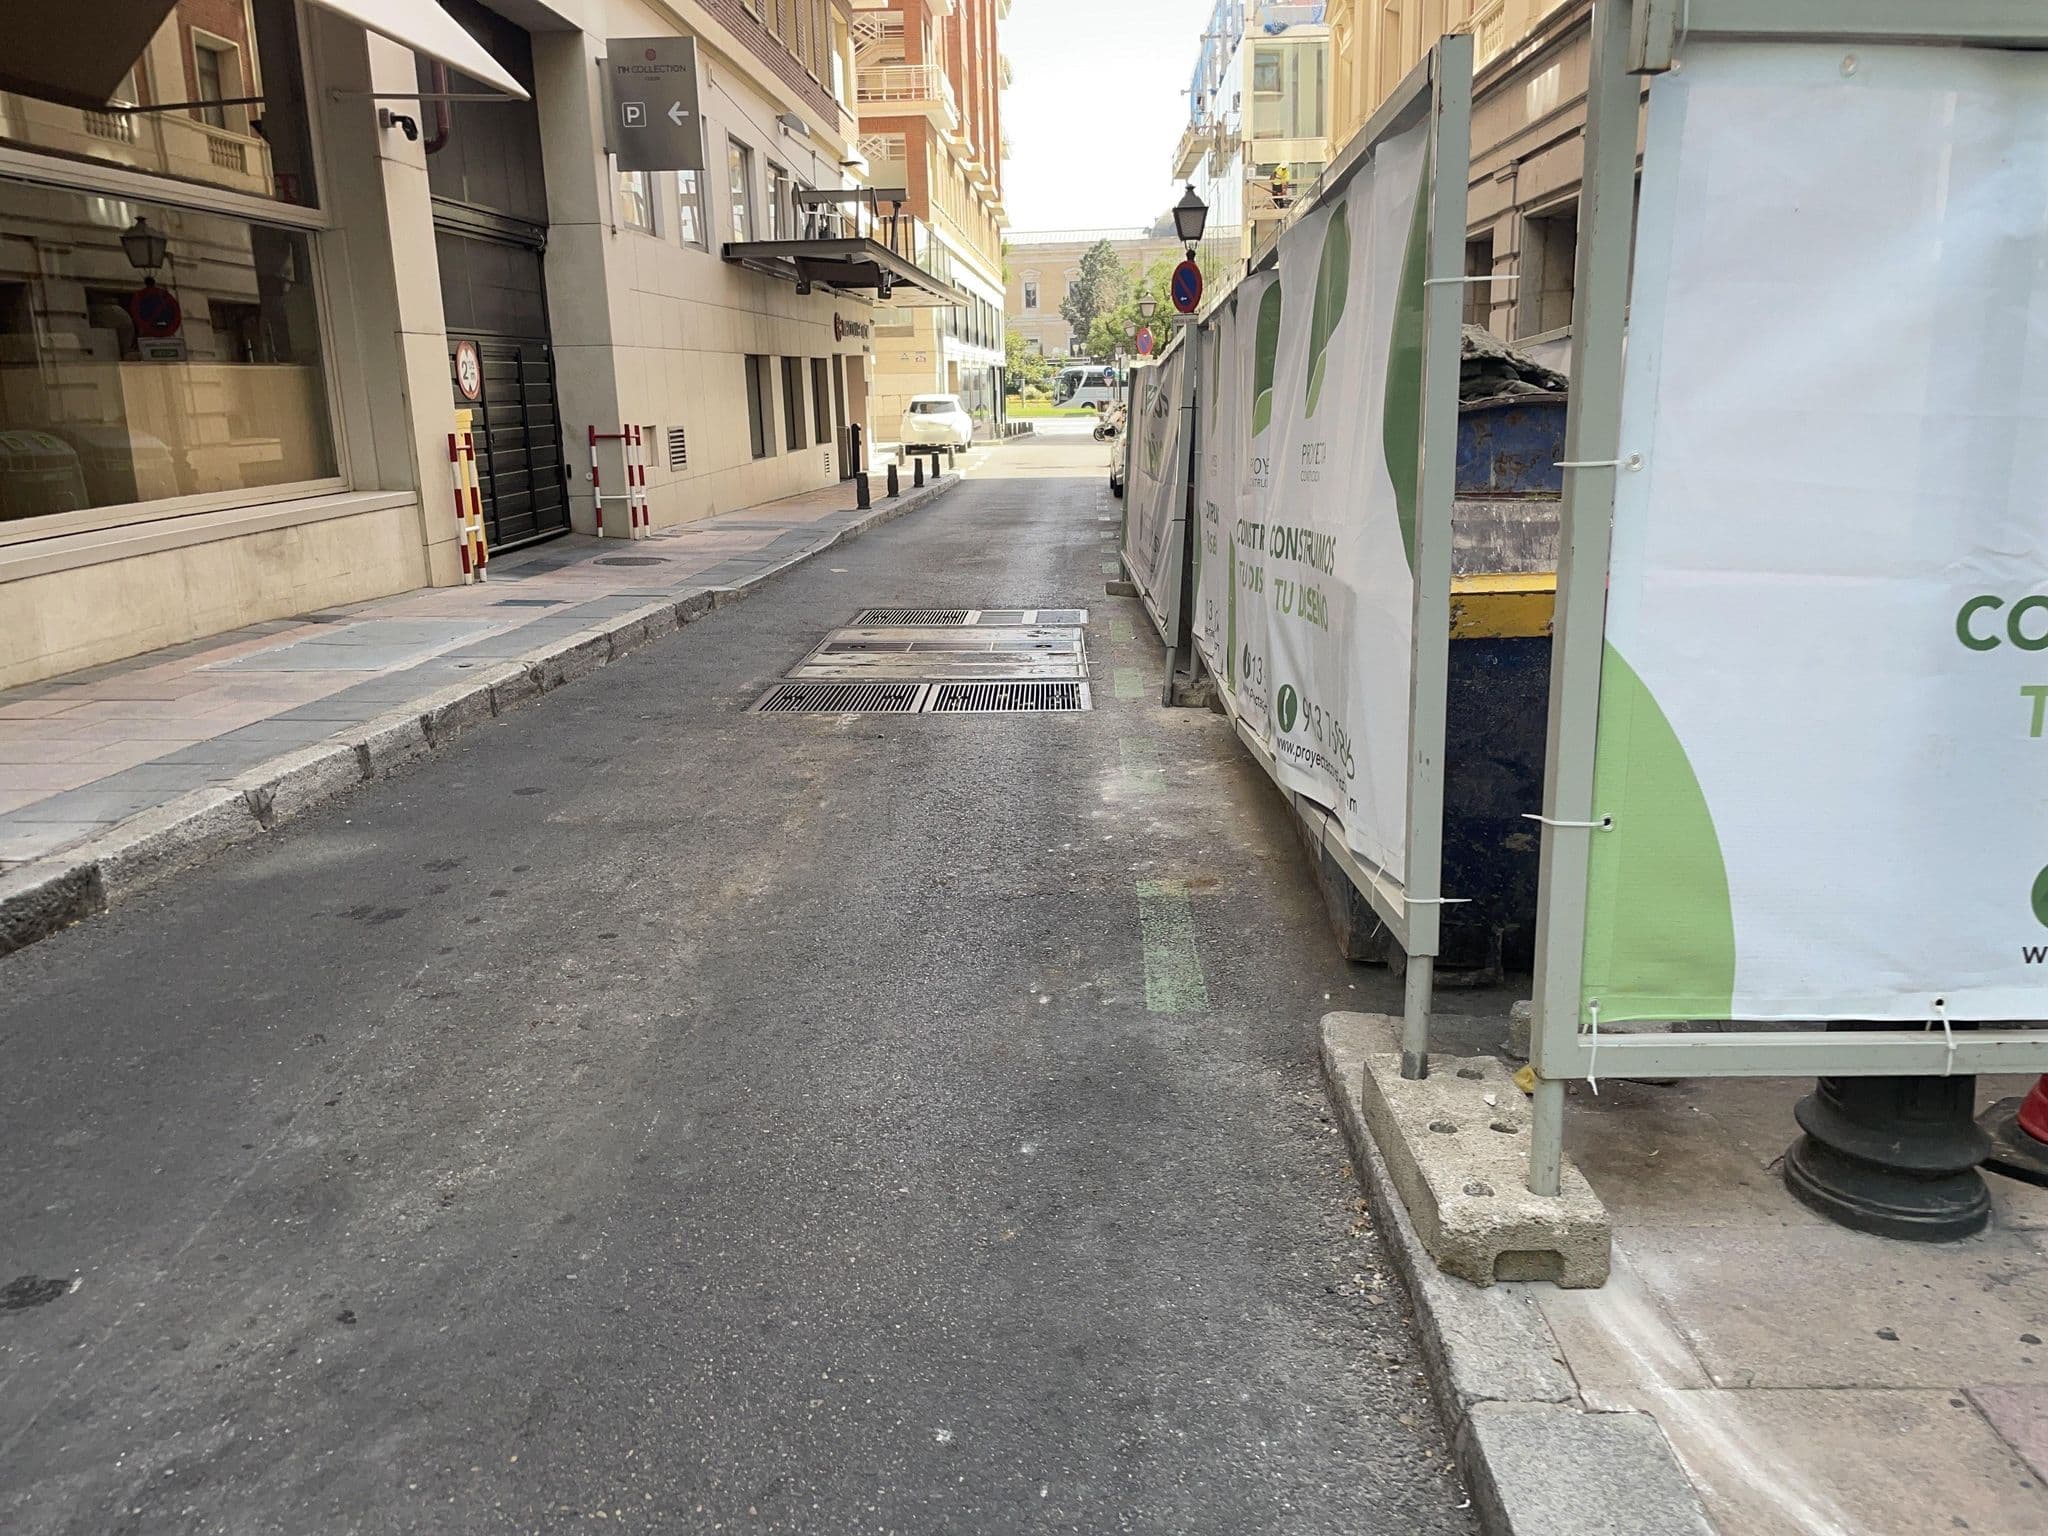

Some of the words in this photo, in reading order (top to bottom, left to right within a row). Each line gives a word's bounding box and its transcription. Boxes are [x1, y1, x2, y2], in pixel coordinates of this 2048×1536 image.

[631, 64, 687, 74] COLLECTION
[626, 106, 640, 123] P
[1273, 577, 1295, 615] TU
